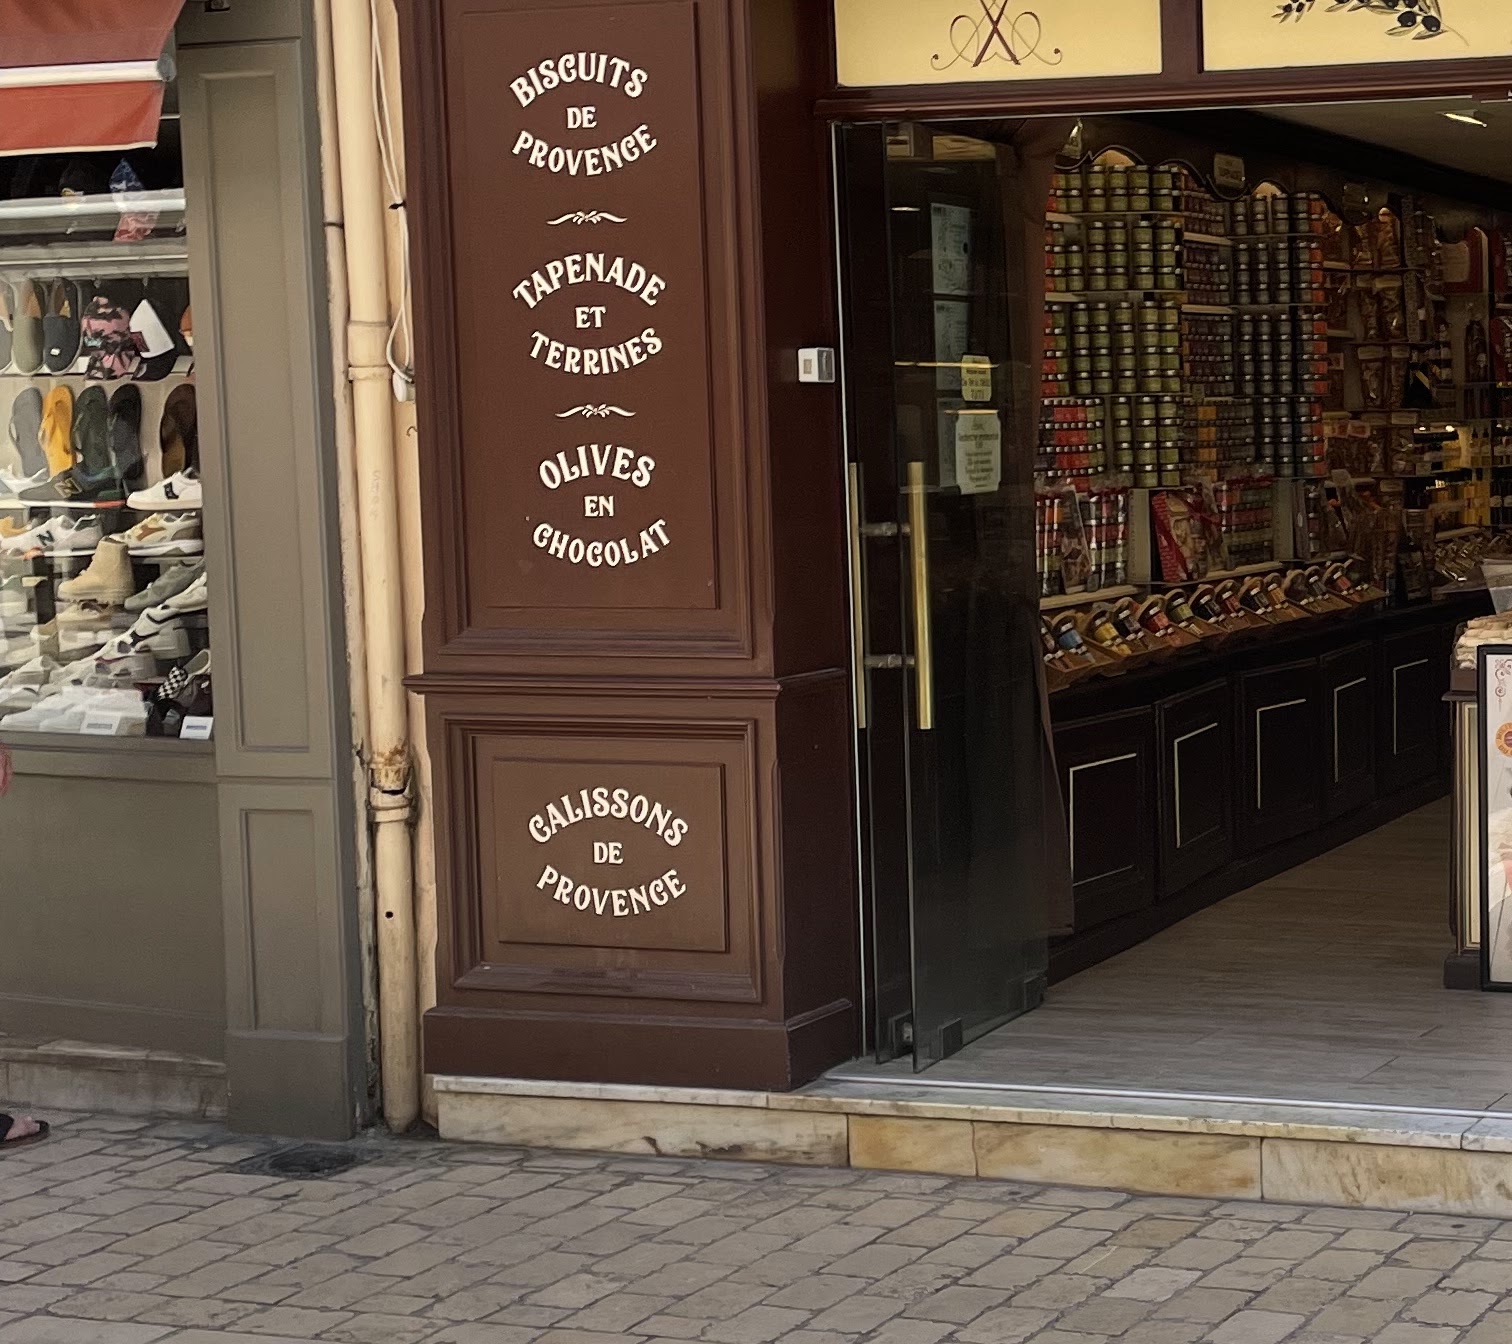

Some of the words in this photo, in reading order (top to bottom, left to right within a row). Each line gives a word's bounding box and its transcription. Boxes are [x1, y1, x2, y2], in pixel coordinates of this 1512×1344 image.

[509, 51, 648, 108] BISCUITS
[566, 106, 597, 129] DE
[511, 124, 657, 176] PROVENCE
[512, 252, 666, 309] TAPENADE
[575, 306, 607, 329] ET
[529, 327, 663, 375] TERRINES
[539, 444, 656, 489] OLIVES
[584, 495, 614, 517] EN
[533, 519, 670, 567] CHOCOLAT
[528, 787, 689, 847] CALISSONS
[593, 841, 624, 864] DE
[536, 864, 687, 917] PROVENCE
